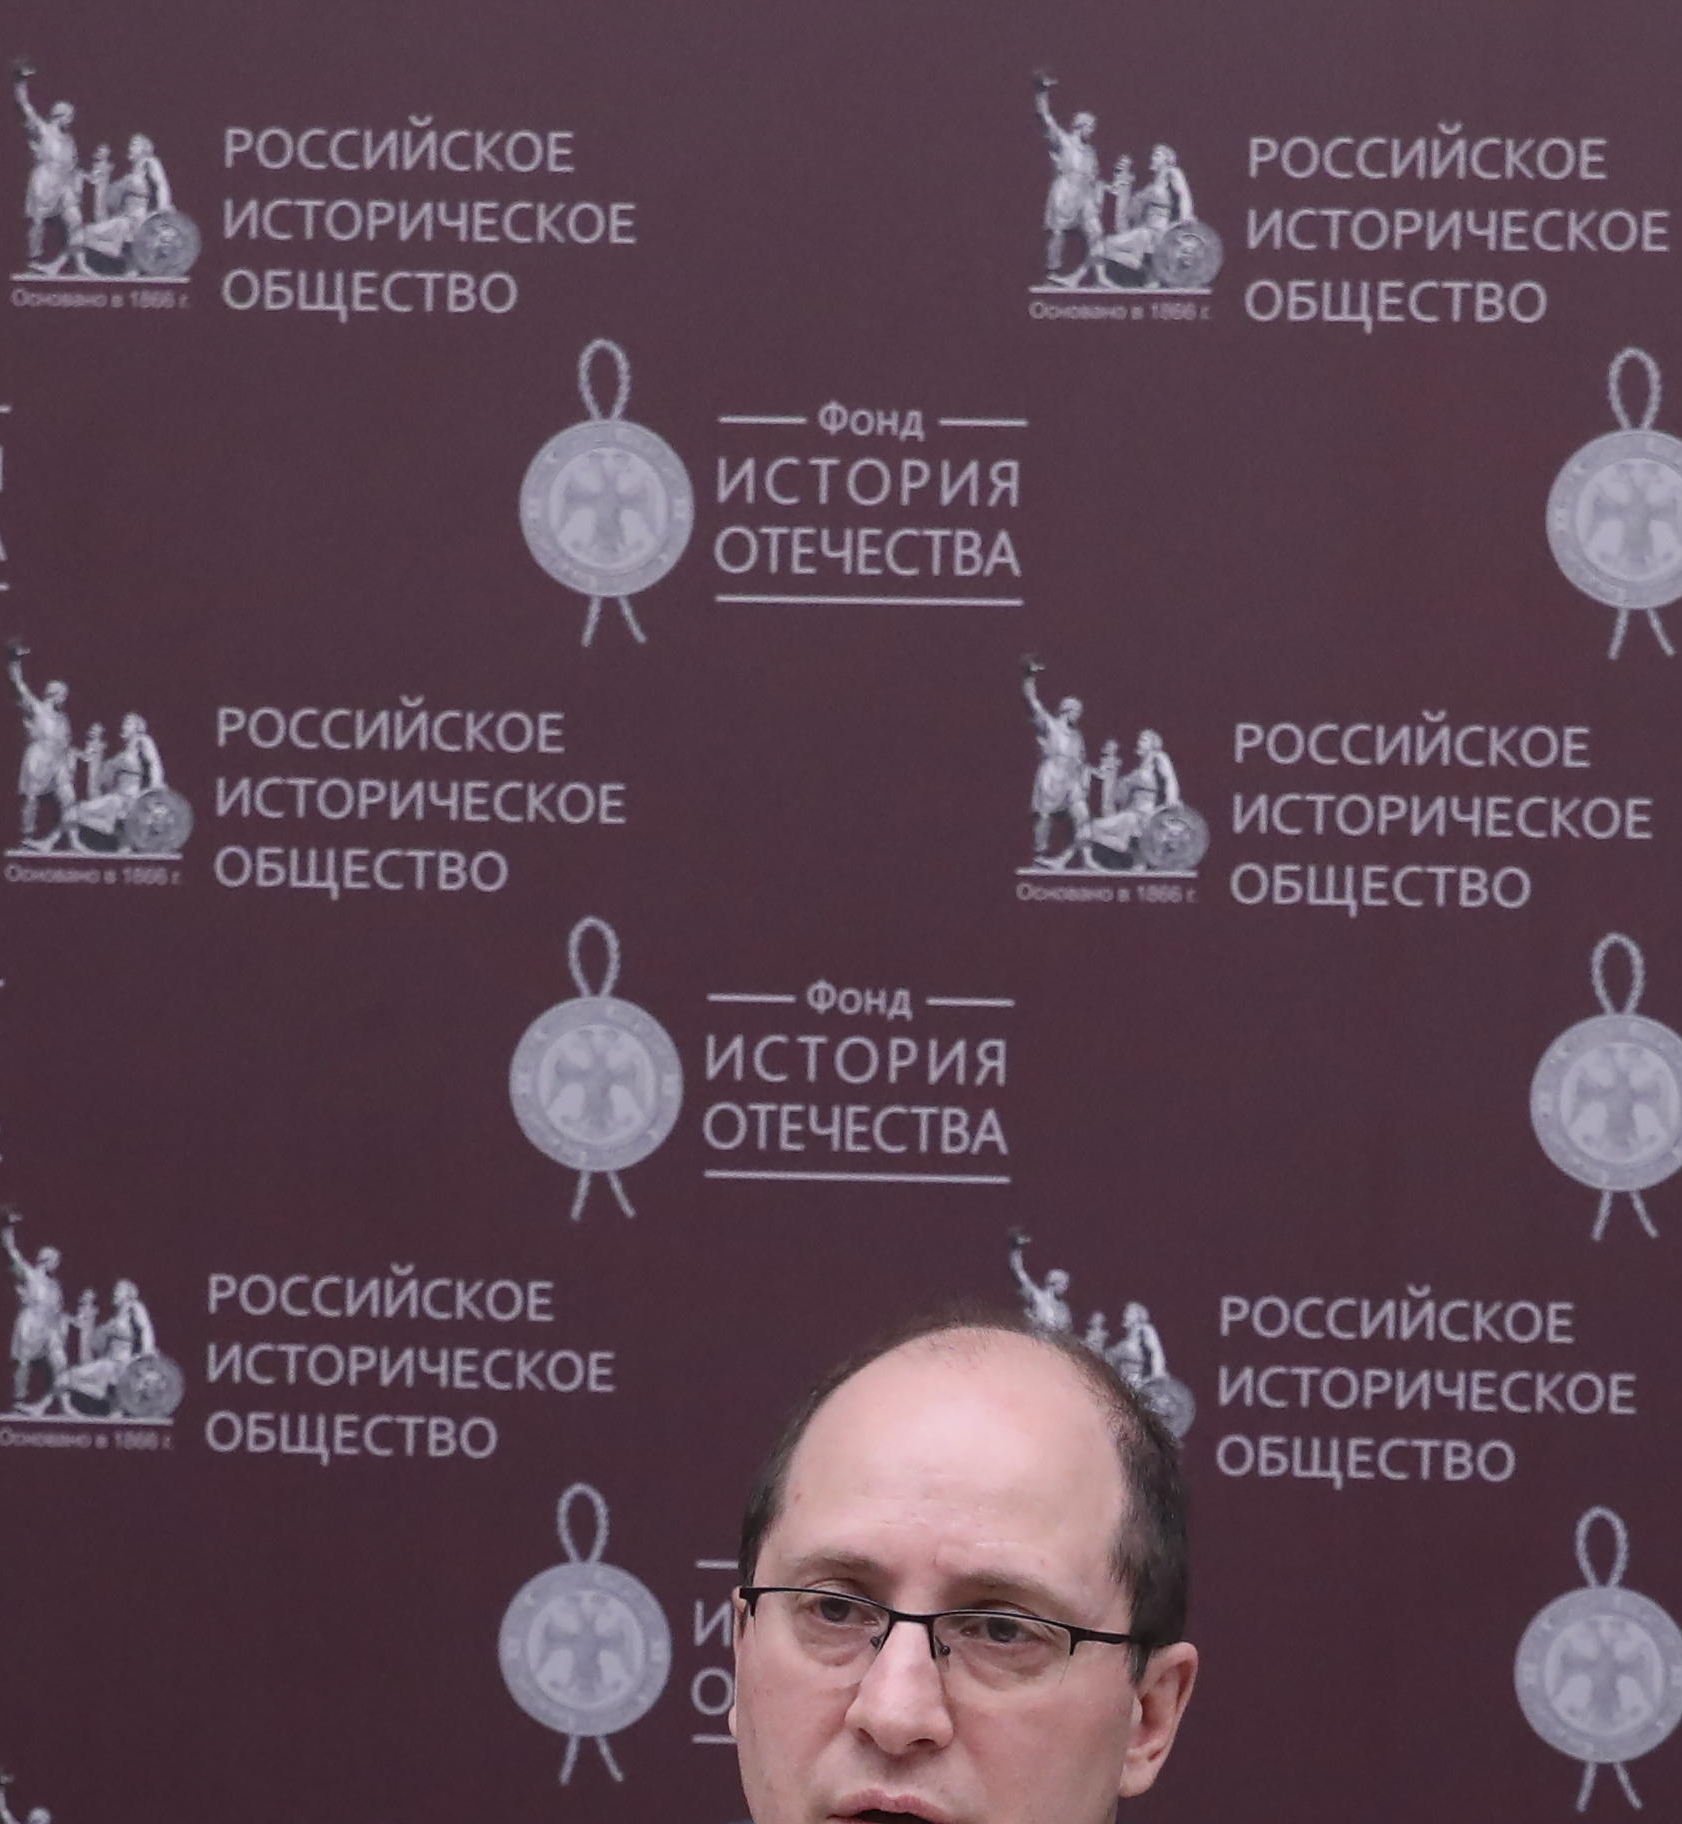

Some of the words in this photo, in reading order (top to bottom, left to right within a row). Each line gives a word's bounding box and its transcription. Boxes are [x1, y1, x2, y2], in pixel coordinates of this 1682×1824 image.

[224, 114, 575, 173] РОССИЙСКОЕ
[1249, 122, 1607, 180] РОССИЙСКОЕ
[223, 197, 636, 244] ИСТОРИЧЕСКОЕ
[1247, 207, 1670, 252] ИСТОРИЧЕСКОЕ
[221, 268, 518, 323] ОБЩЕСТВО
[1244, 278, 1548, 334] ОБЩЕСТВО
[818, 400, 925, 441] Фонд
[717, 456, 1020, 507] ИСТОРИЯ
[713, 525, 1021, 577] ОТЕЧЕСТВА
[217, 695, 564, 754] РОССИЙСКОЕ
[1234, 710, 1590, 768] РОССИЙСКОЕ
[216, 776, 626, 825] ИСТОРИЧЕСКОЕ
[1232, 792, 1653, 840] ИСТОРИЧЕСКОЕ
[213, 845, 509, 901] ОБЩЕСТВО
[1230, 862, 1532, 918] ОБЩЕСТВО
[806, 979, 913, 1021] Фонд
[705, 1034, 1007, 1086] ИСТОРИЯ
[702, 1101, 1008, 1155] ОТЕЧЕСТВА
[208, 1263, 554, 1322] РОССИЙСКОЕ
[1220, 1284, 1574, 1344] РОССИЙСКОЕ
[207, 1342, 615, 1393] ИСТОРИЧЕСКОЕ
[1218, 1365, 1636, 1415] ИСТОРИЧЕСКОЕ
[205, 1410, 498, 1466] ОБЩЕСТВО
[1215, 1434, 1516, 1490] ОБЩЕСТВО
